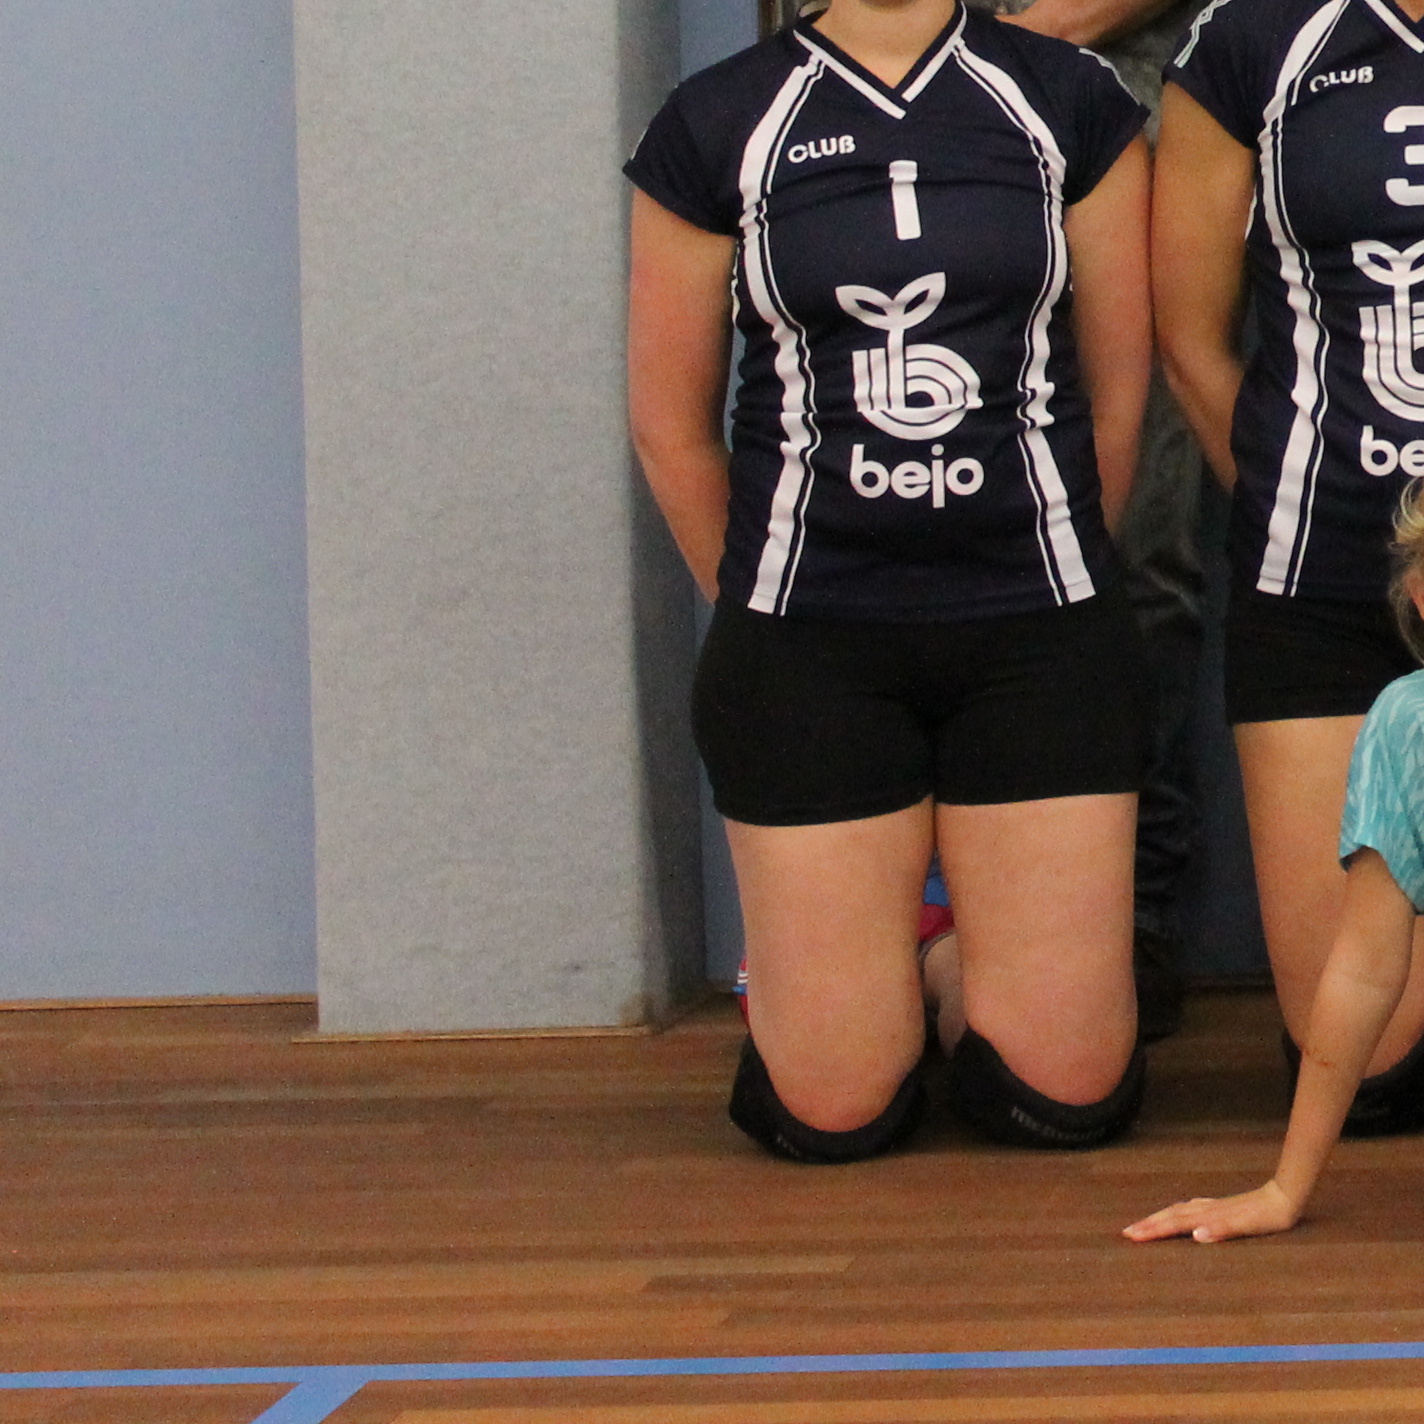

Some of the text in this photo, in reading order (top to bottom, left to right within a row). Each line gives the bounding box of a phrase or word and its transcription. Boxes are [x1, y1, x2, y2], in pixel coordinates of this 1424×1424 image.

[1308, 64, 1375, 93] CLUB
[787, 134, 856, 164] CLUB
[888, 159, 922, 241] 1
[849, 443, 985, 509] bejo
